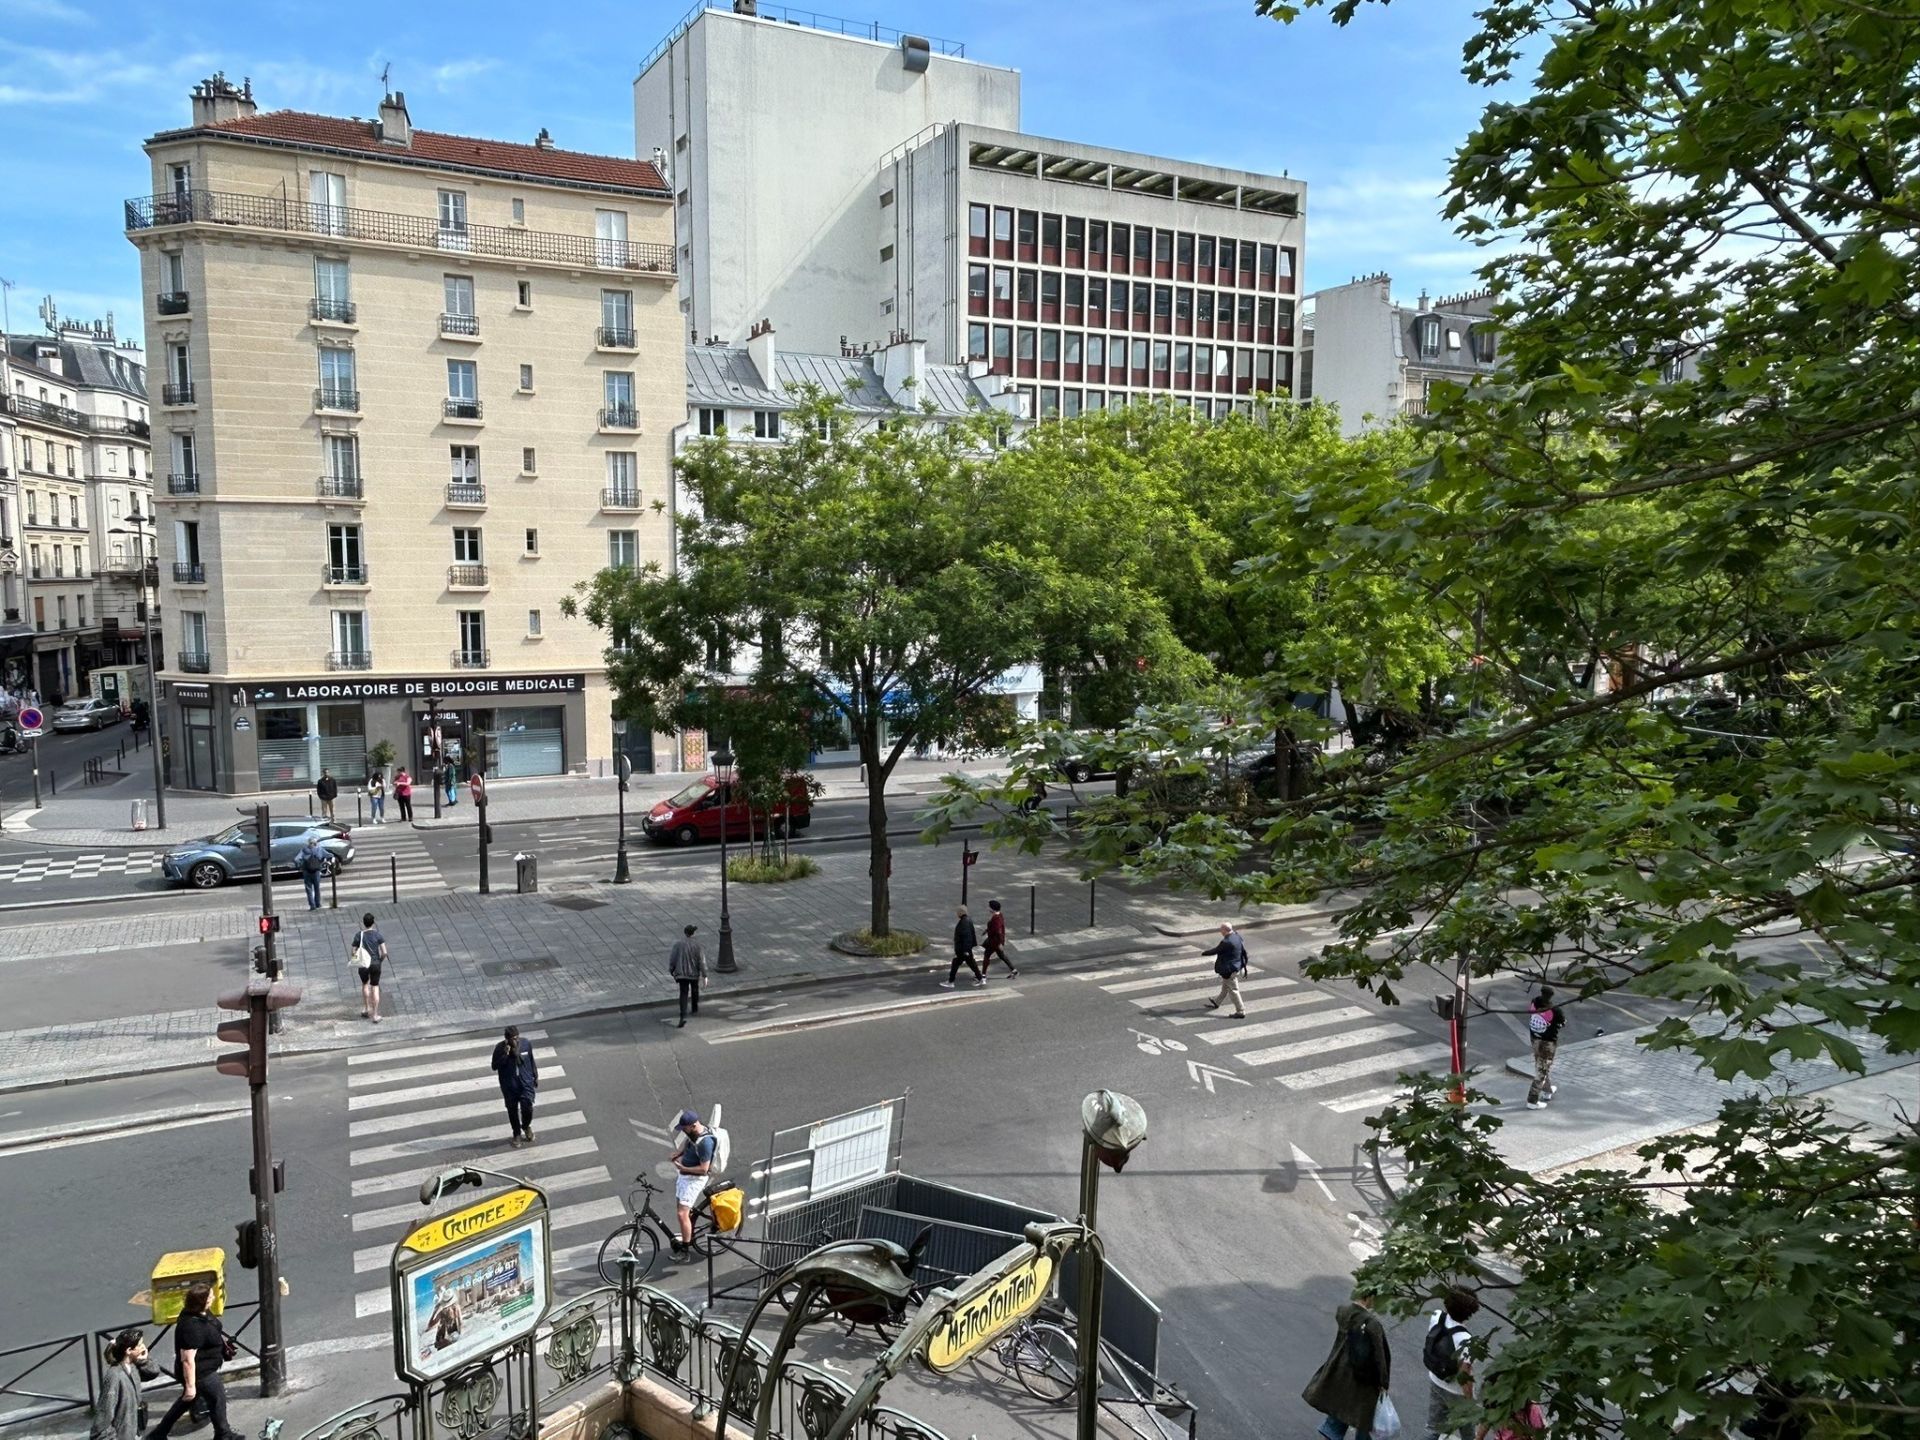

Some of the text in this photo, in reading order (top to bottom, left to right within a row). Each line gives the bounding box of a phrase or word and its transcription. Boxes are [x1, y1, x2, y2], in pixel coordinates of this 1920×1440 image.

[286, 678, 575, 698] LABORATOIRE DE BIOLOGIE MEDICALE
[947, 1267, 1037, 1355] METROPOLITAIN
